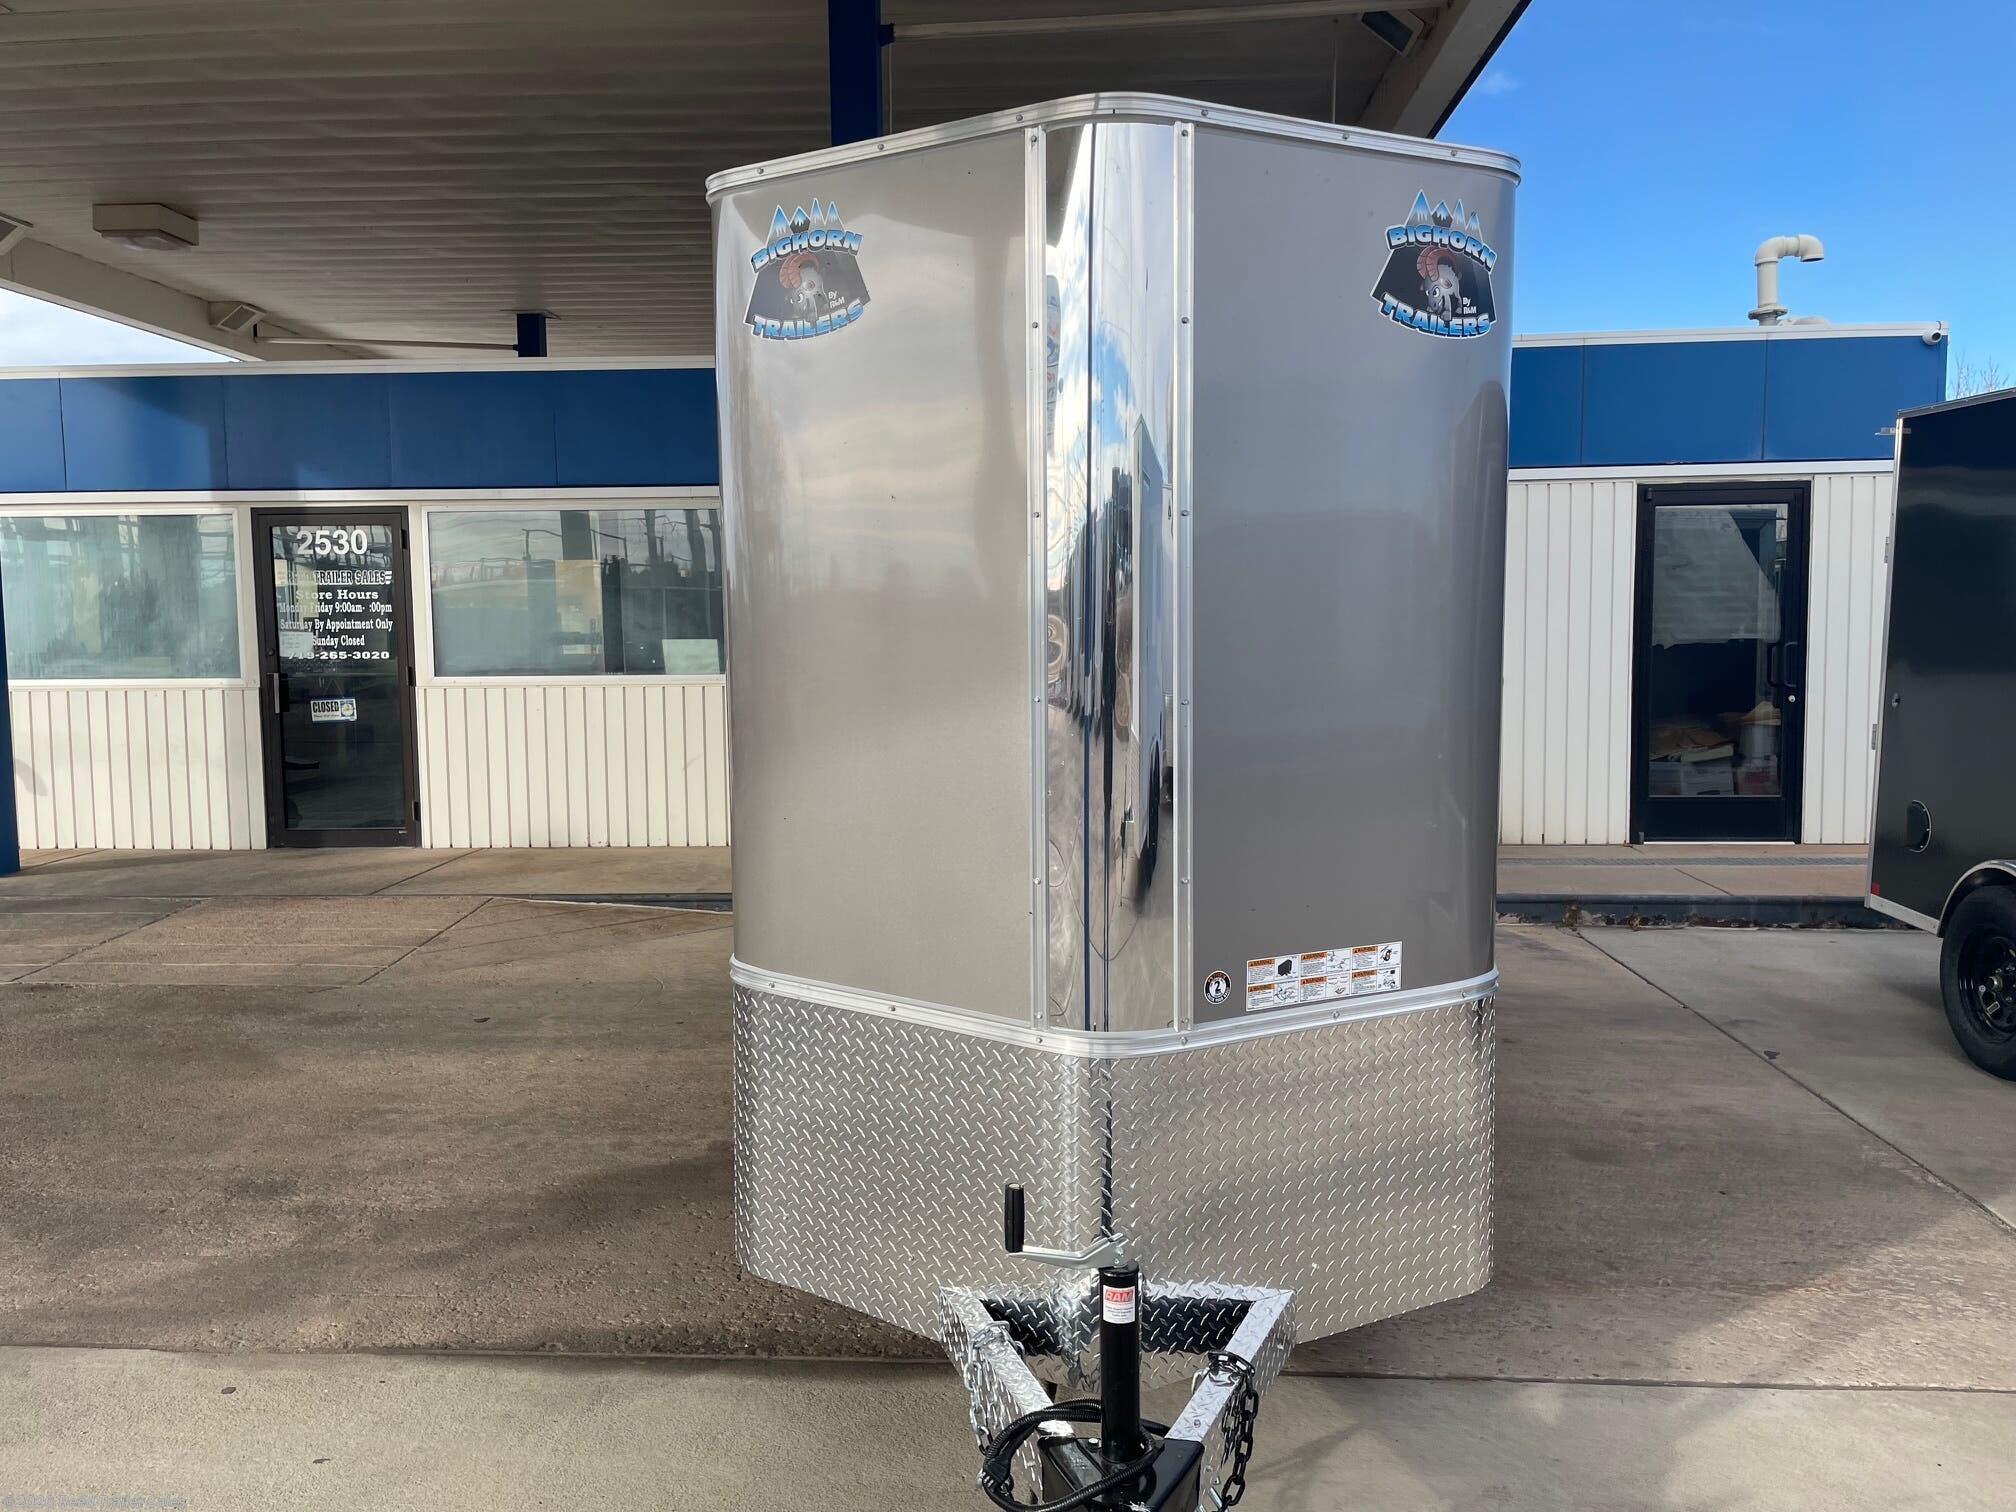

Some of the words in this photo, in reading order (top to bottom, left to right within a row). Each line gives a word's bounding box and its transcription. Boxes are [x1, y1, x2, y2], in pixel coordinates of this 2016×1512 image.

[751, 229, 863, 273] BIGHORN
[1386, 224, 1497, 272] BIGHORN
[1462, 297, 1471, 307] By
[752, 299, 864, 340] TRAILERS
[1380, 291, 1491, 337] TRAILERS
[296, 529, 368, 555] 2530
[313, 570, 353, 585] TRAILER
[354, 570, 386, 585] SALES
[296, 590, 333, 600] Store
[337, 589, 379, 600] Hours
[280, 618, 313, 632] Saturday
[314, 618, 325, 632] By
[326, 618, 374, 632] Appointment
[375, 618, 394, 632] Only
[312, 635, 340, 649] Sunday
[340, 634, 365, 646] Closed
[312, 701, 339, 713] CLOSED
[1214, 980, 1222, 992] 2
[1105, 1291, 1133, 1302] RAM
